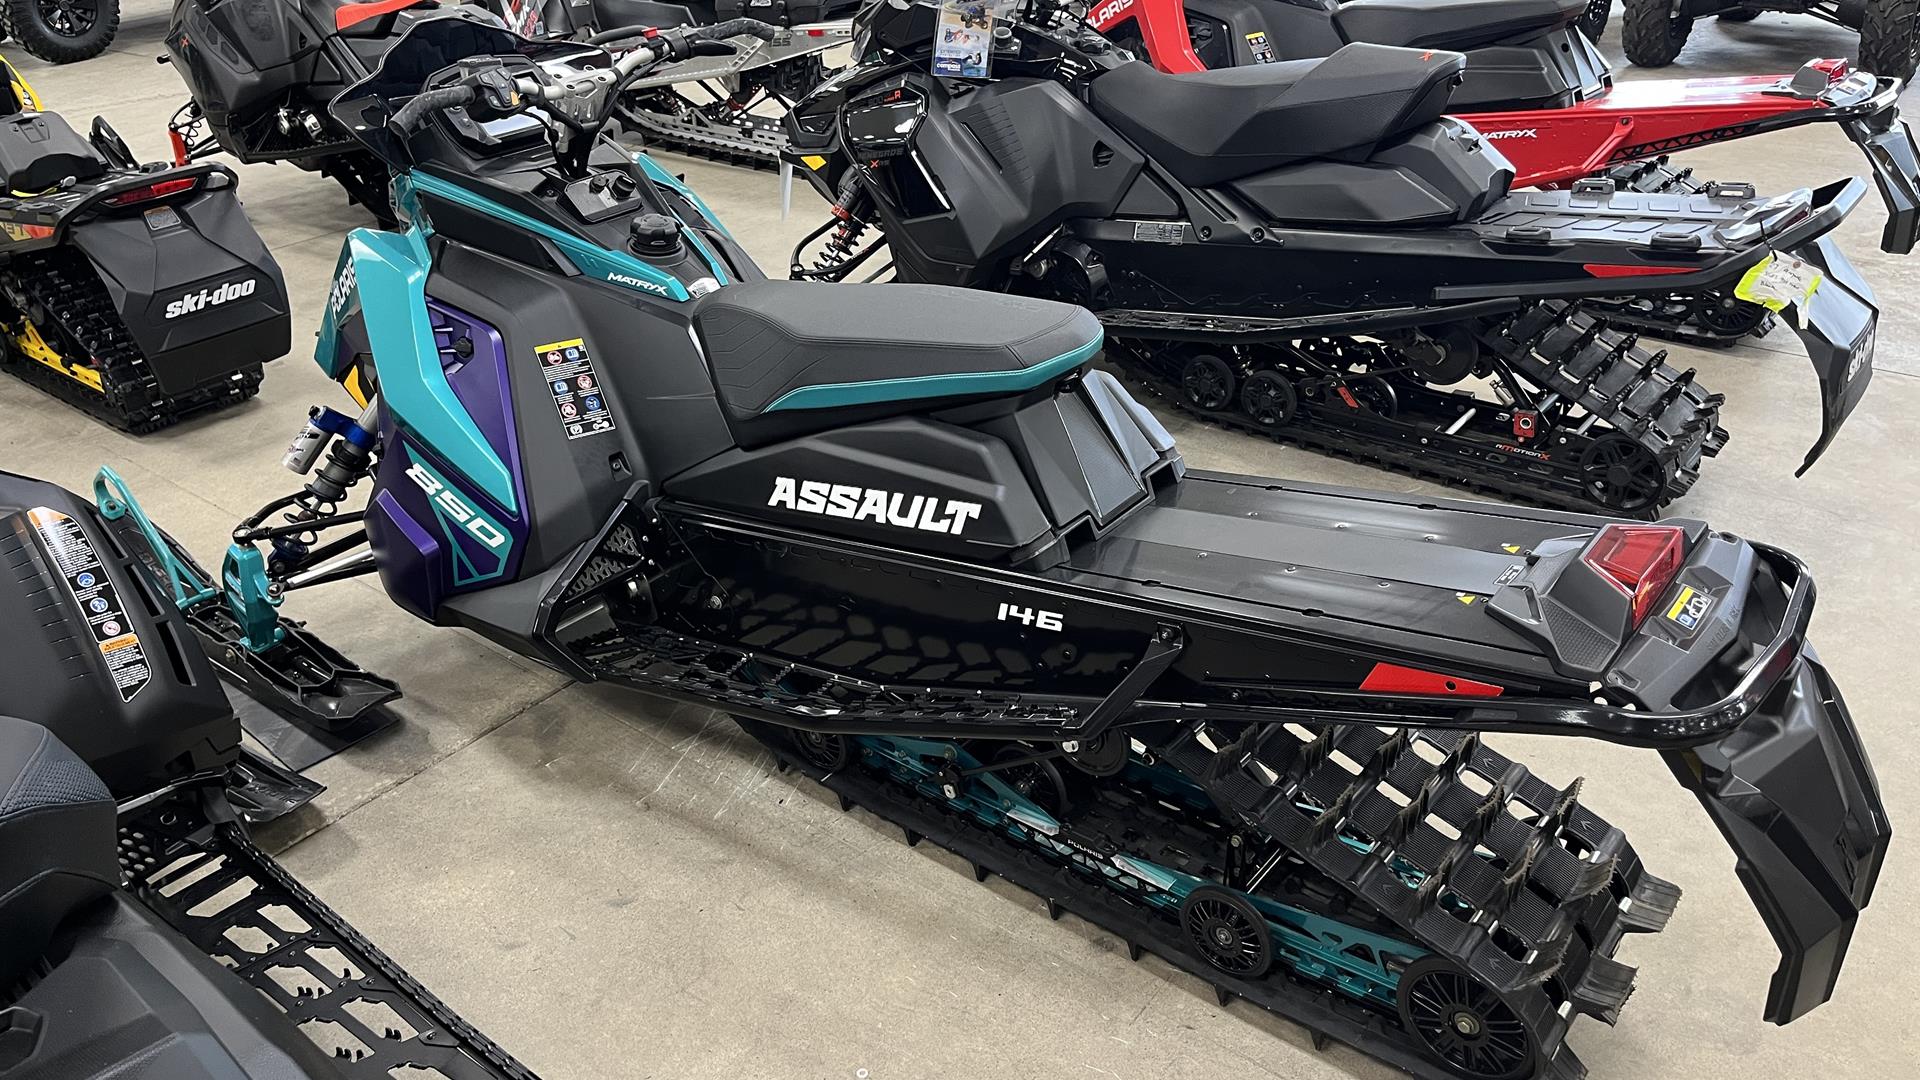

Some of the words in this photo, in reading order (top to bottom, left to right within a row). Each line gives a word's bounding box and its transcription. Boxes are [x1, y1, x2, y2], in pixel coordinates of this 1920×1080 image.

[165, 279, 256, 319] ski-doo
[606, 271, 668, 296] MATRYX
[405, 462, 506, 548] 850
[767, 476, 983, 535] ASSAULT
[997, 602, 1064, 632] 146
